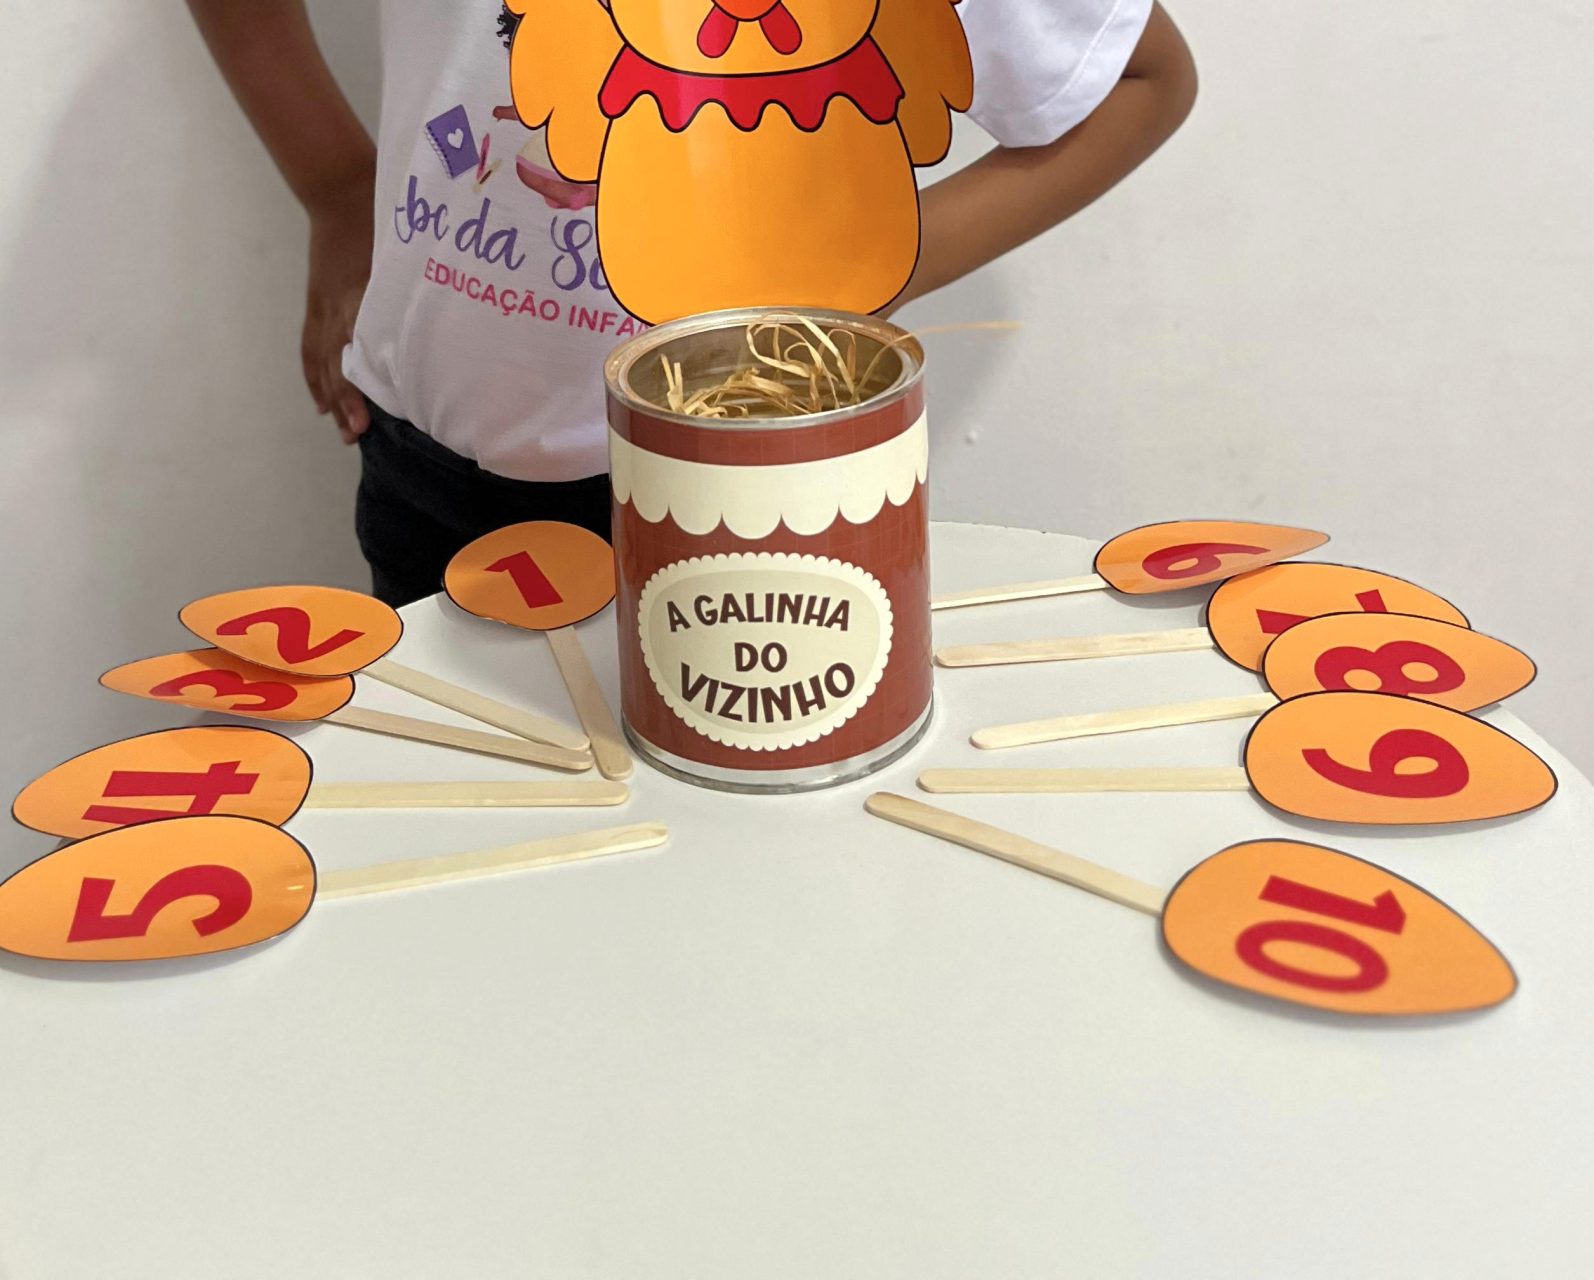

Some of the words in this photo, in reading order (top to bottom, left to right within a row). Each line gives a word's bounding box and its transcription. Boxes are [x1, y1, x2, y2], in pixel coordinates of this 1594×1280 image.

[455, 197, 526, 270] da
[424, 256, 561, 321] EDUCAÇÃO
[484, 550, 564, 609] 1
[1142, 542, 1271, 580] 6
[216, 606, 366, 665] 2
[667, 600, 691, 633] A
[693, 592, 850, 631] GALINHA
[734, 642, 788, 673] DO
[1314, 640, 1466, 696] 8
[149, 669, 298, 712] 3
[680, 662, 855, 724] VIZINHO
[81, 760, 260, 826] 4
[1301, 728, 1470, 799] 9
[67, 864, 253, 943] 5
[1235, 875, 1407, 994] 10
